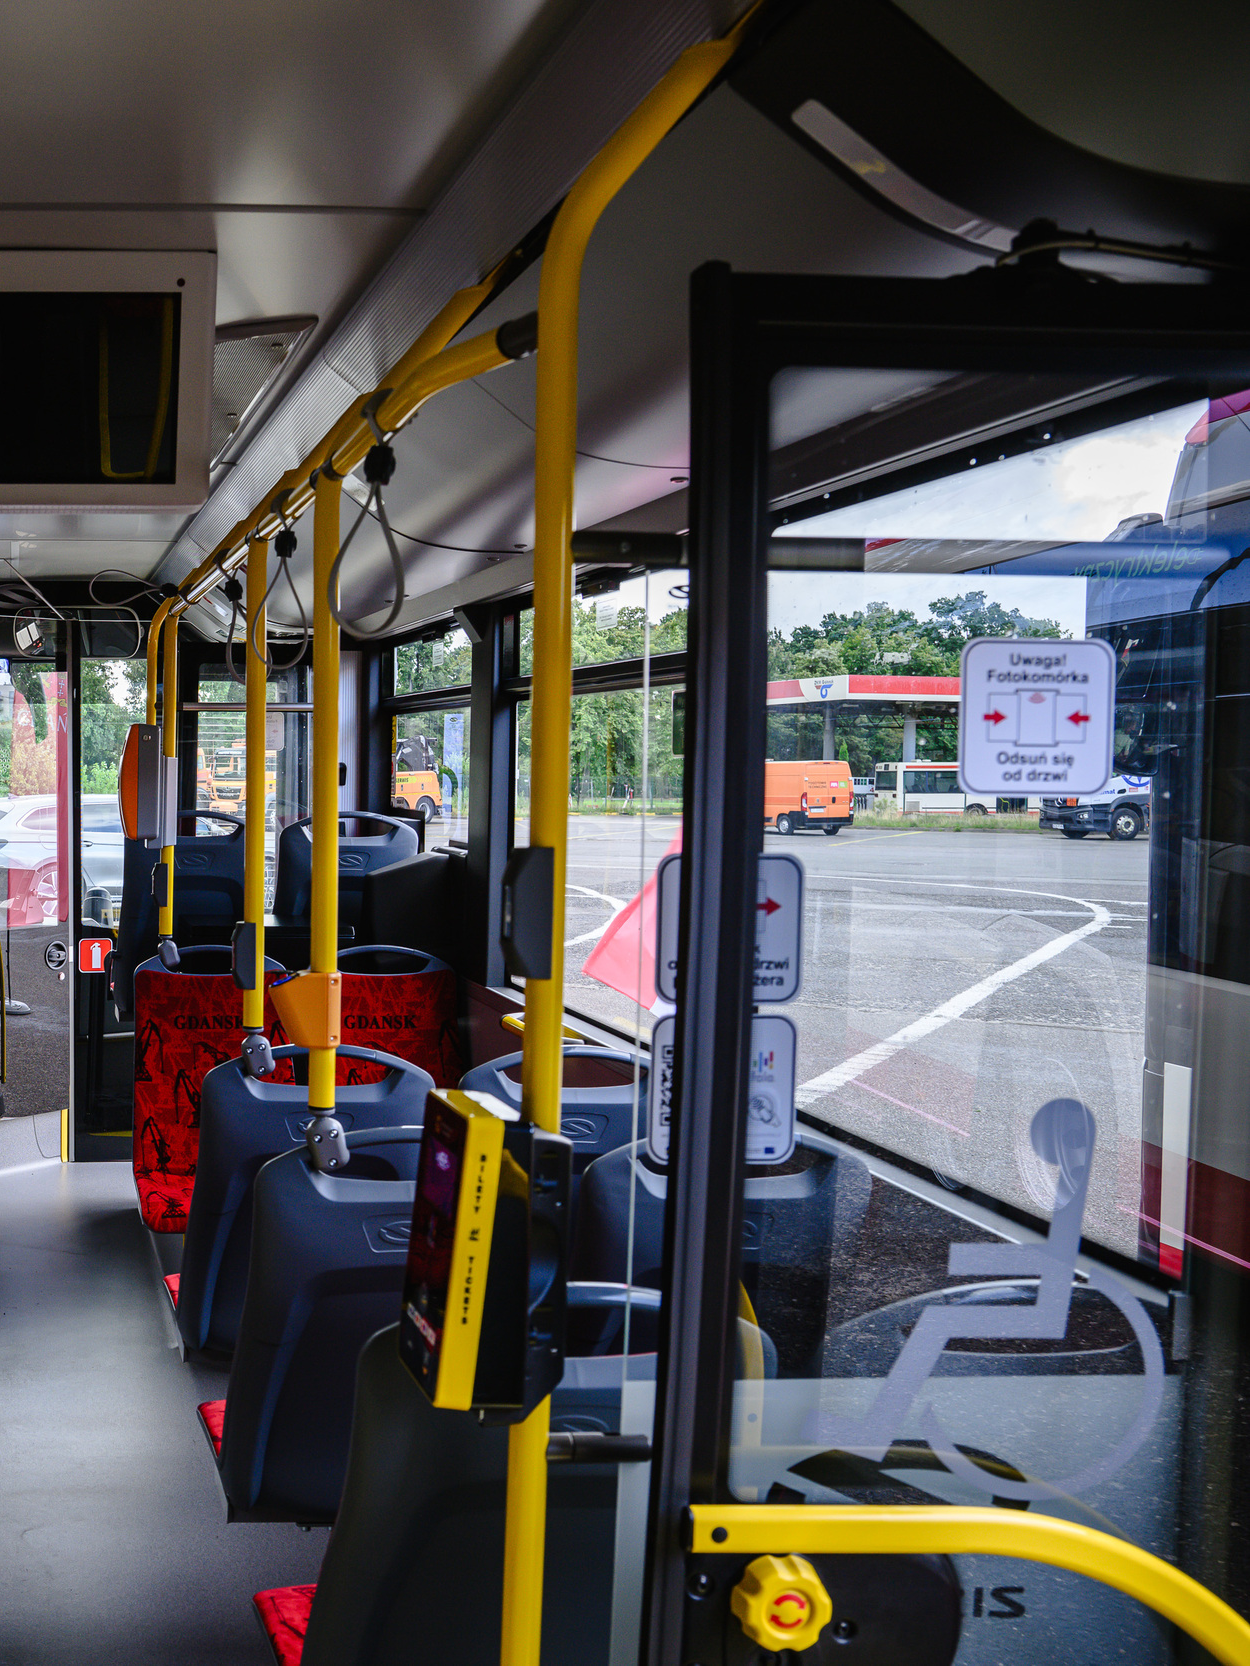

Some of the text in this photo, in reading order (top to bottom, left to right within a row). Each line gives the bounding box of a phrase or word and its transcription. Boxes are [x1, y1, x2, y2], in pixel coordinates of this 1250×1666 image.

[1009, 653, 1067, 670] Uwaga!
[986, 670, 1090, 684] Fotokomórka
[996, 751, 1075, 768] Odsuń się
[1002, 769, 1068, 782] od drzwi
[173, 1013, 244, 1030] GDAŃSK
[344, 1013, 417, 1030] GDAŃSK
[474, 1154, 488, 1214] BILETY
[462, 1256, 475, 1326] TICKETS
